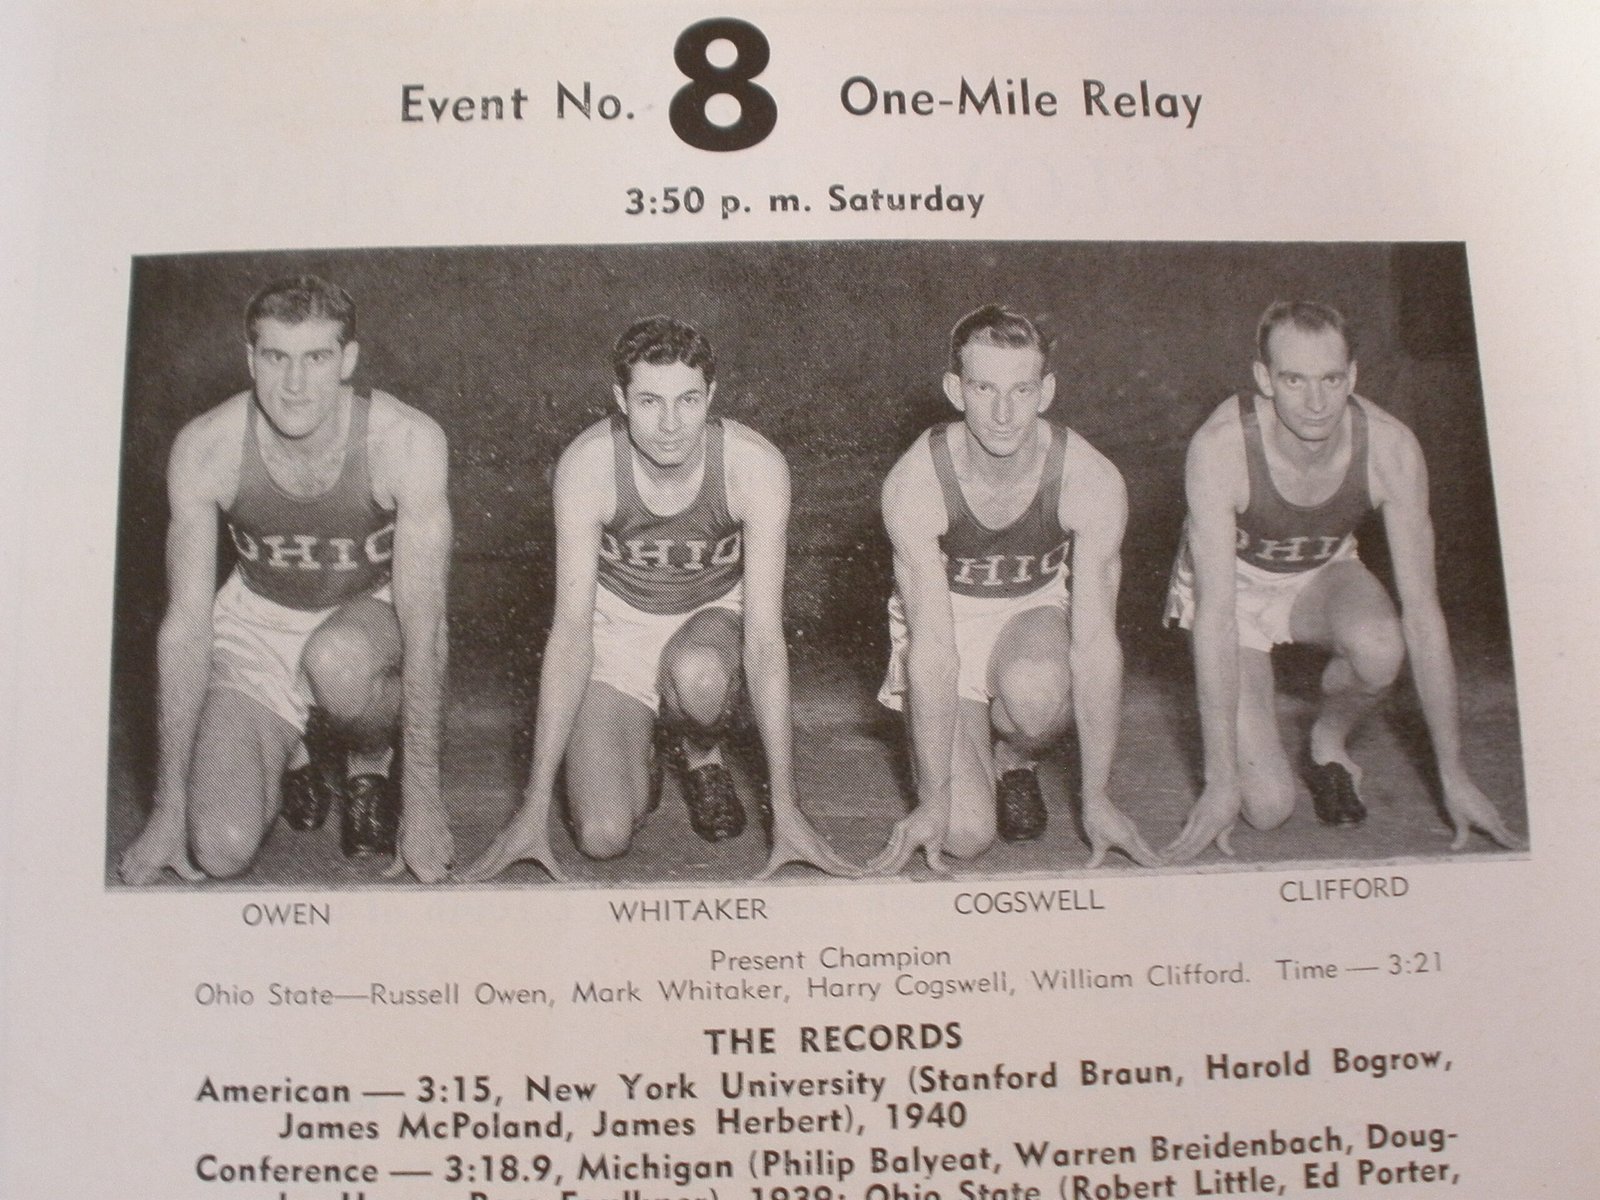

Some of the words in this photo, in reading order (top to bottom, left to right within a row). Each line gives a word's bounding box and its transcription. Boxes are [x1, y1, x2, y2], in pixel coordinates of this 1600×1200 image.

[402, 84, 528, 123] Event
[557, 81, 634, 120] No.
[669, 17, 778, 153] 8
[840, 76, 1057, 117] One-Mile
[1083, 79, 1202, 129] Relay
[625, 186, 704, 216] 3:50
[722, 195, 750, 220] p.
[770, 195, 811, 212] m.
[829, 184, 984, 218] Saturday
[954, 889, 1105, 914] COGSWELL
[1280, 876, 1409, 902] CLIFFORD
[242, 903, 330, 926] OWEN
[609, 898, 768, 922] WHITAKER
[711, 950, 806, 971] Present
[820, 946, 951, 971] Champion
[195, 983, 254, 1005] Ohio
[475, 982, 554, 1008] Owen,
[572, 981, 642, 1003] Mark
[658, 979, 789, 1003] Whitaker,
[808, 976, 881, 1001] Harry
[895, 971, 1015, 999] Cogswell,
[1031, 969, 1132, 991] William
[1147, 962, 1250, 986] Clifford.
[1275, 959, 1337, 980] Time
[1389, 952, 1441, 975] 3:21
[703, 1027, 776, 1055] THE
[800, 1021, 963, 1053] RECORDS
[195, 1076, 350, 1104] American
[416, 1075, 503, 1107] 3:15,
[525, 1075, 597, 1103] New
[618, 1072, 698, 1101] York
[721, 1069, 886, 1102] University
[908, 1061, 1057, 1095] (Stanford
[1080, 1060, 1183, 1087] Braun,
[1206, 1049, 1311, 1080] Harold
[1332, 1048, 1452, 1078] Bogrow,
[278, 1112, 379, 1140] James
[398, 1110, 573, 1143] McPoland,
[592, 1110, 696, 1137] James
[716, 1104, 865, 1136] Herbert),
[886, 1101, 967, 1130] 1940
[195, 1154, 379, 1184] Conference
[444, 1154, 563, 1186] 3:18.9,
[577, 1152, 733, 1187] Michigan
[748, 1149, 855, 1182] (Philip
[870, 1146, 1001, 1180] Balyeat,
[1013, 1141, 1136, 1168] Warren
[1150, 1126, 1353, 1162] Breidenbach,
[1366, 1124, 1458, 1153] Doug-
[958, 1180, 1041, 1200] State
[1059, 1174, 1177, 1200] (Robert
[1194, 1166, 1286, 1196] Little,
[1303, 1161, 1339, 1189] Ed
[1357, 1159, 1460, 1186] Porter,
